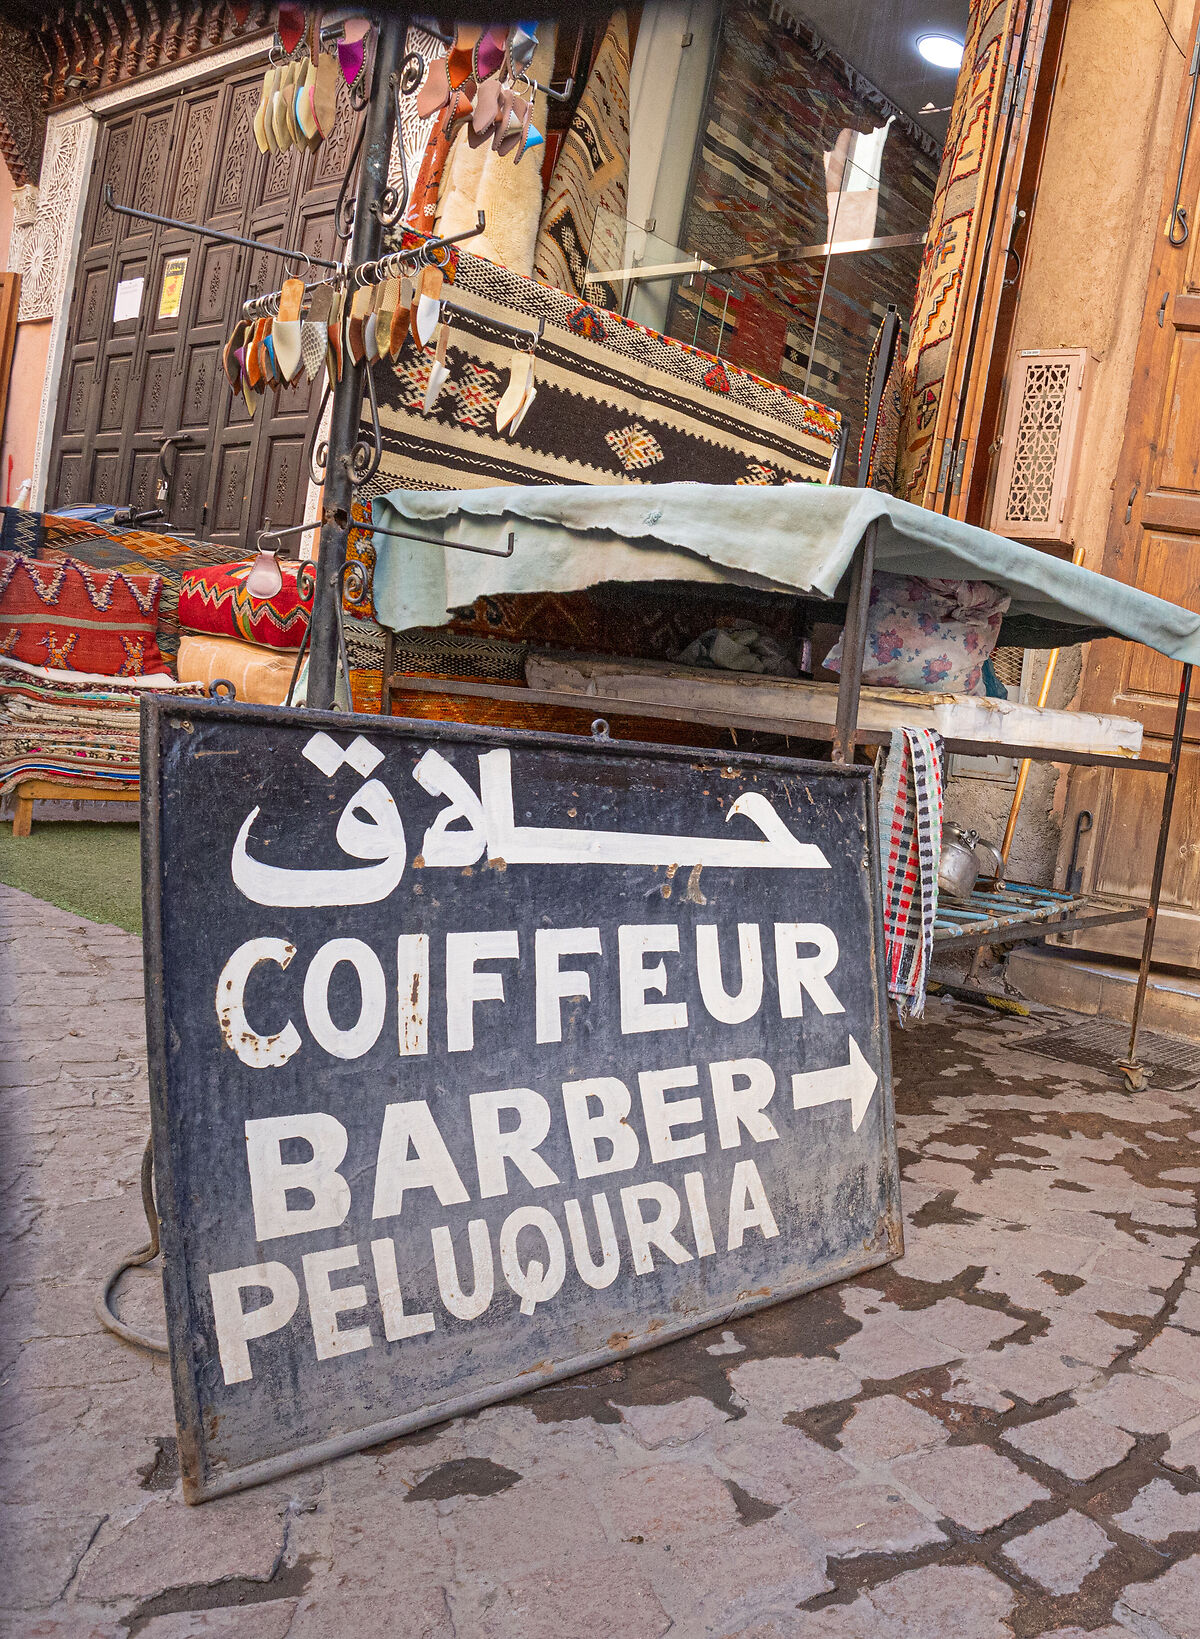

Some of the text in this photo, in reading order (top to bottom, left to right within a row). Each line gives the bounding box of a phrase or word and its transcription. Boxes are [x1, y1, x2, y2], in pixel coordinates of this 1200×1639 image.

[215, 922, 847, 1069] COIFFEUR
[244, 1057, 780, 1242] BARBER
[208, 1158, 781, 1386] PELUQURIA
